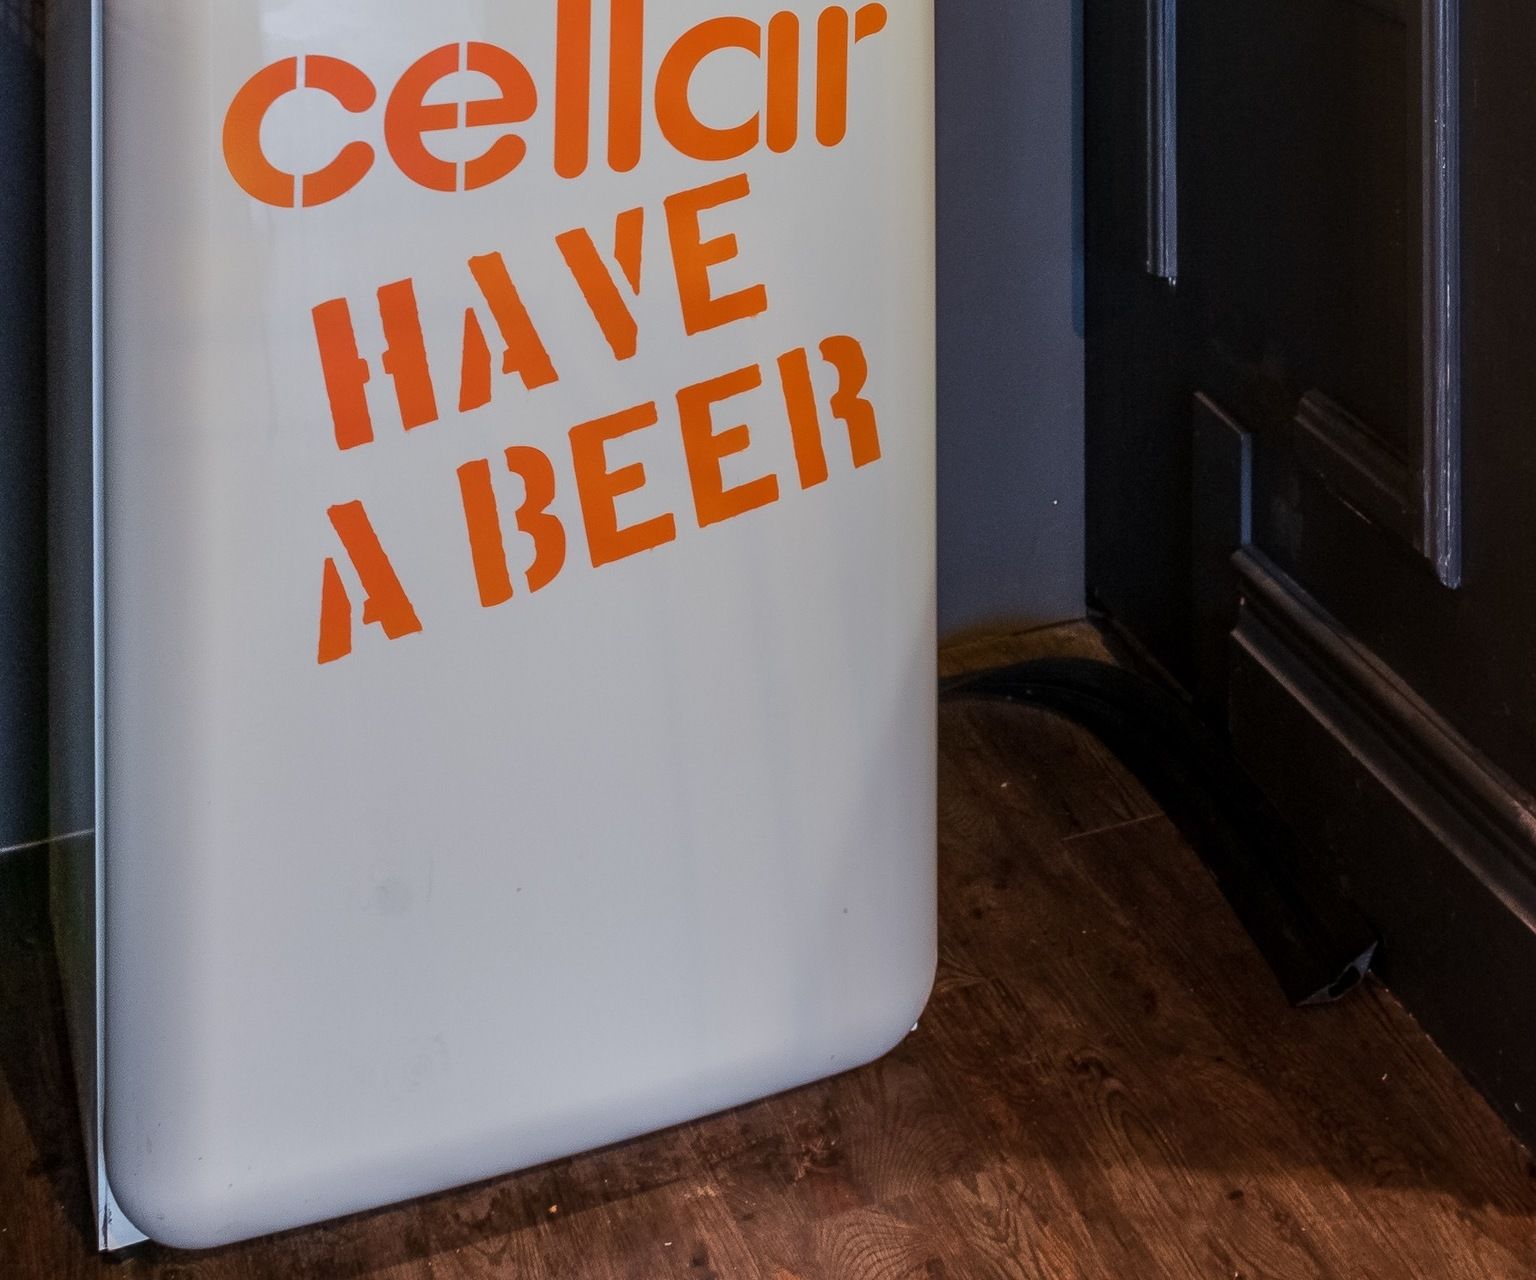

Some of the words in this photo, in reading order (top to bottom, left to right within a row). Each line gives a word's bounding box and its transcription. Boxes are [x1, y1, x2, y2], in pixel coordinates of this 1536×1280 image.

[311, 173, 767, 450] HAVE
[318, 500, 422, 664] A
[456, 335, 881, 607] BEER
